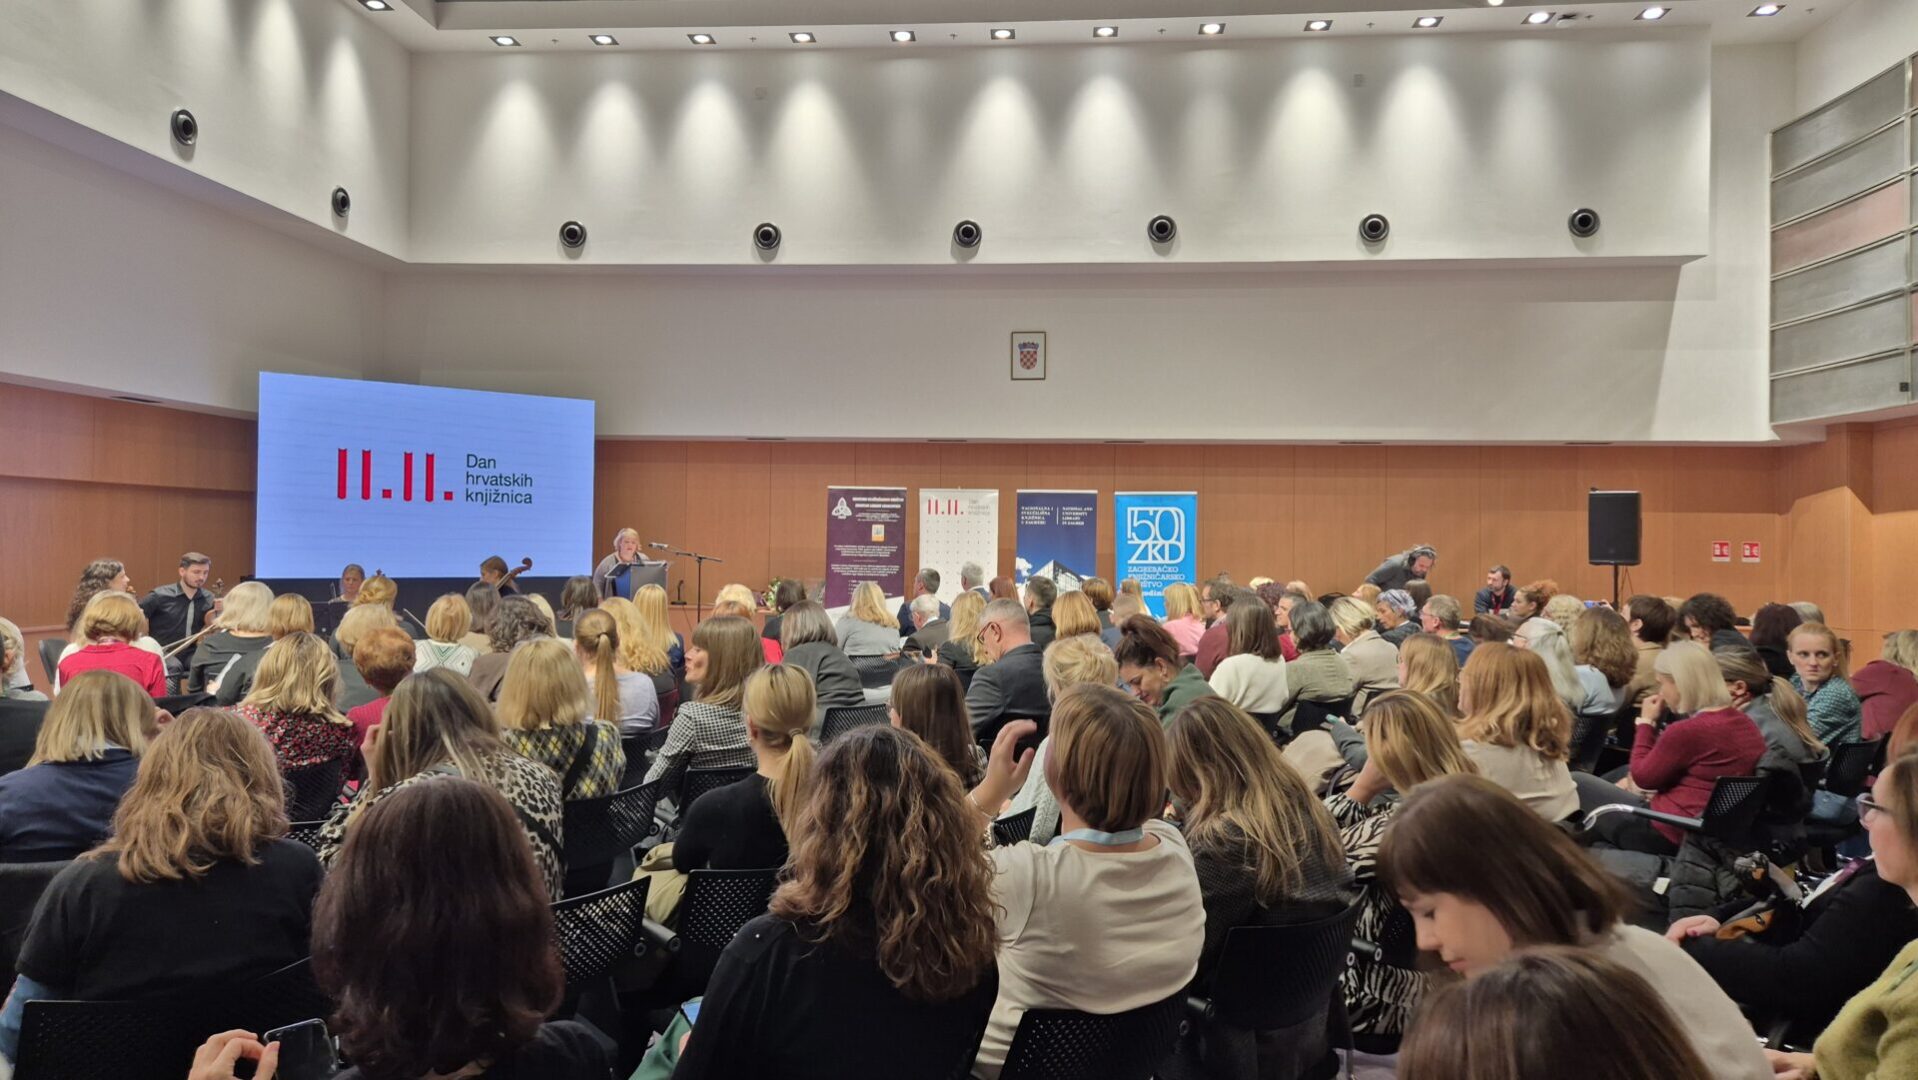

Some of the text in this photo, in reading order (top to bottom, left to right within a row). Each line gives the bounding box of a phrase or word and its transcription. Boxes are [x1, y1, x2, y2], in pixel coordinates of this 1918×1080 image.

[466, 453, 496, 469] Dan
[465, 471, 533, 487] hrvatskih
[465, 488, 533, 506] knjižnica
[1130, 507, 1181, 543] 50
[1128, 541, 1185, 564] ZKD
[1128, 565, 1179, 573] ZAGREBAČKO
